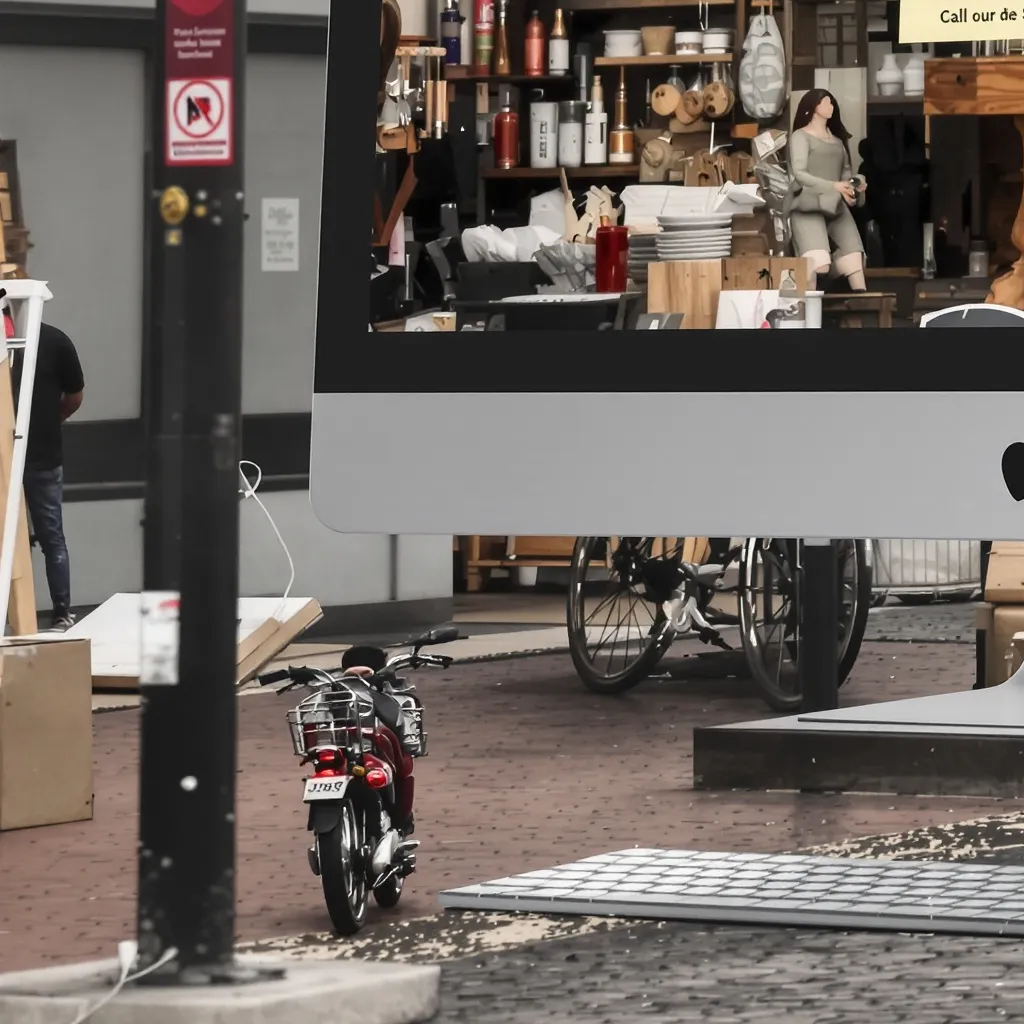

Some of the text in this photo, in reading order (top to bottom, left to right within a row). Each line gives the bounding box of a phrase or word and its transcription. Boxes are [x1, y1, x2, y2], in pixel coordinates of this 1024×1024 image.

[940, 7, 968, 23] Call
[972, 10, 996, 23] our
[1000, 6, 1018, 21] de
